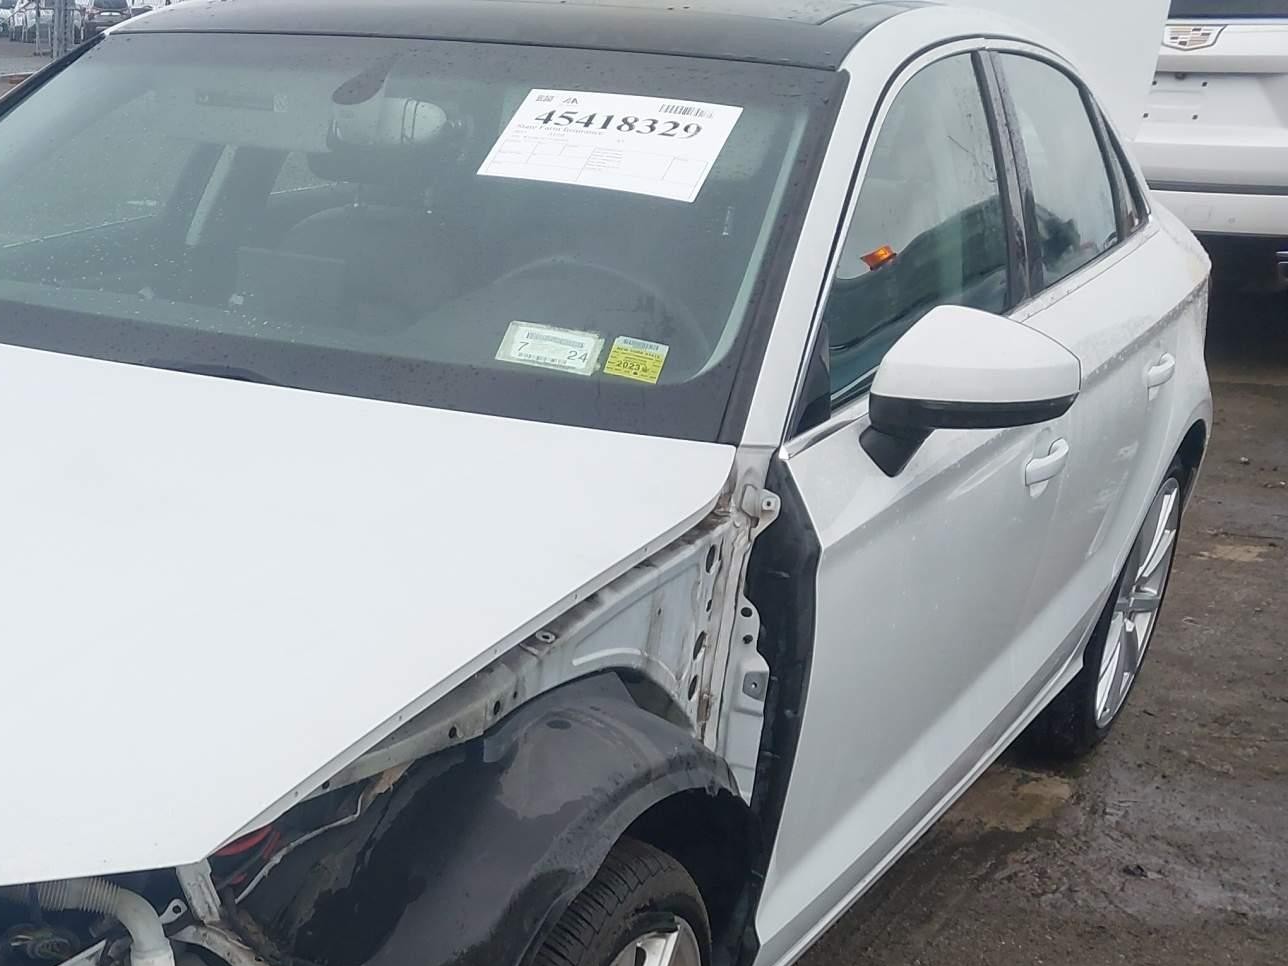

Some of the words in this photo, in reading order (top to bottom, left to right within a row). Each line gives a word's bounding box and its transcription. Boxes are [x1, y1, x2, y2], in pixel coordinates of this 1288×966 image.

[534, 109, 703, 138] 45418329
[517, 341, 529, 352] 7
[567, 350, 589, 363] 24
[616, 360, 641, 371] 2023
